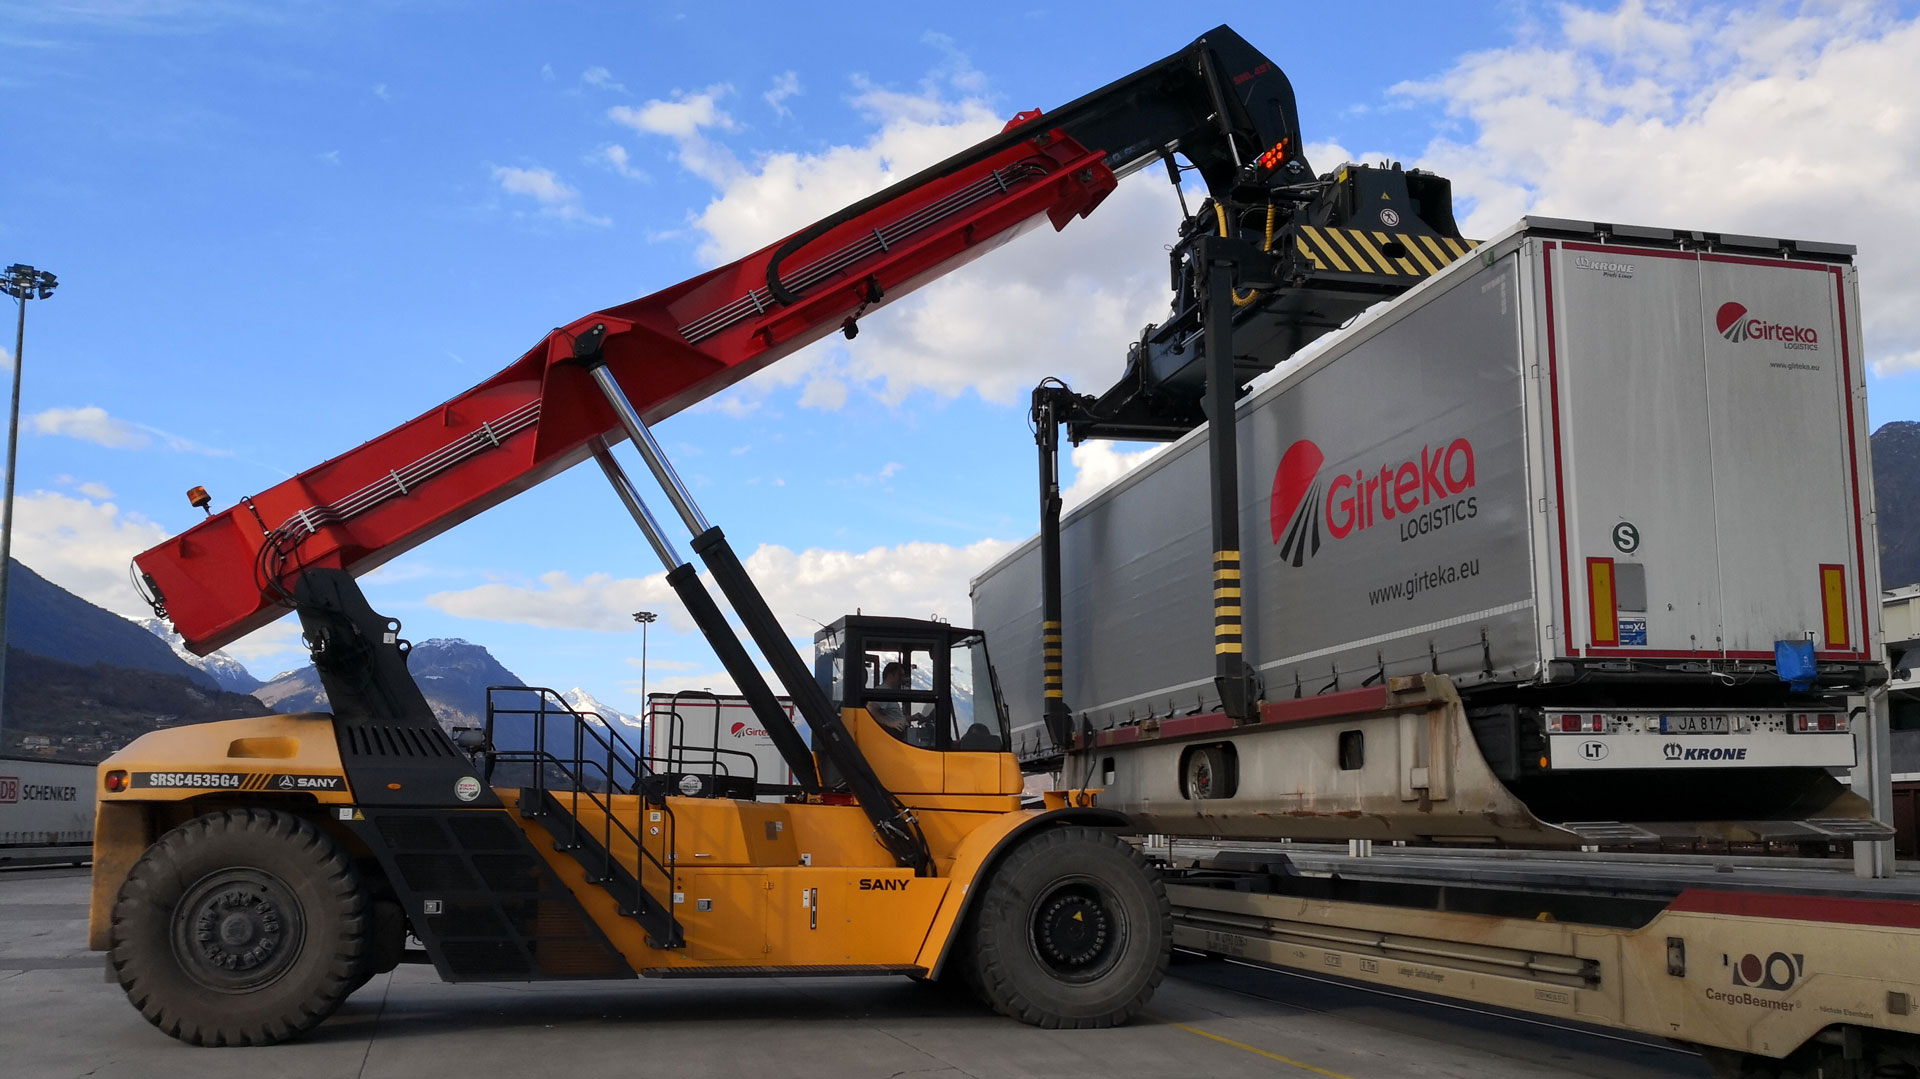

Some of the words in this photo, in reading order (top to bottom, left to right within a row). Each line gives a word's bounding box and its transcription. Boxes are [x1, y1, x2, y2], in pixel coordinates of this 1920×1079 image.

[1590, 261, 1634, 273] KRONE
[1747, 319, 1818, 343] Girteka
[1784, 343, 1818, 351] LOGISTICS
[1770, 362, 1820, 371] www.girteka.eu
[1325, 437, 1476, 539] Girteka
[1400, 496, 1477, 542] LOGISTICS
[1617, 525, 1635, 550] S
[1368, 557, 1480, 605] www.girteka.eu
[1679, 716, 1696, 731] JA
[1700, 715, 1722, 731] 817
[1585, 744, 1602, 757] LT
[1684, 748, 1747, 760] KRONE
[149, 773, 239, 787] SRSC4535G4
[297, 777, 337, 788] SANY
[0, 781, 16, 799] DB
[23, 784, 77, 801] SCHENKER
[859, 878, 910, 891] SANY
[1706, 988, 1795, 1012] CargoBeamer
